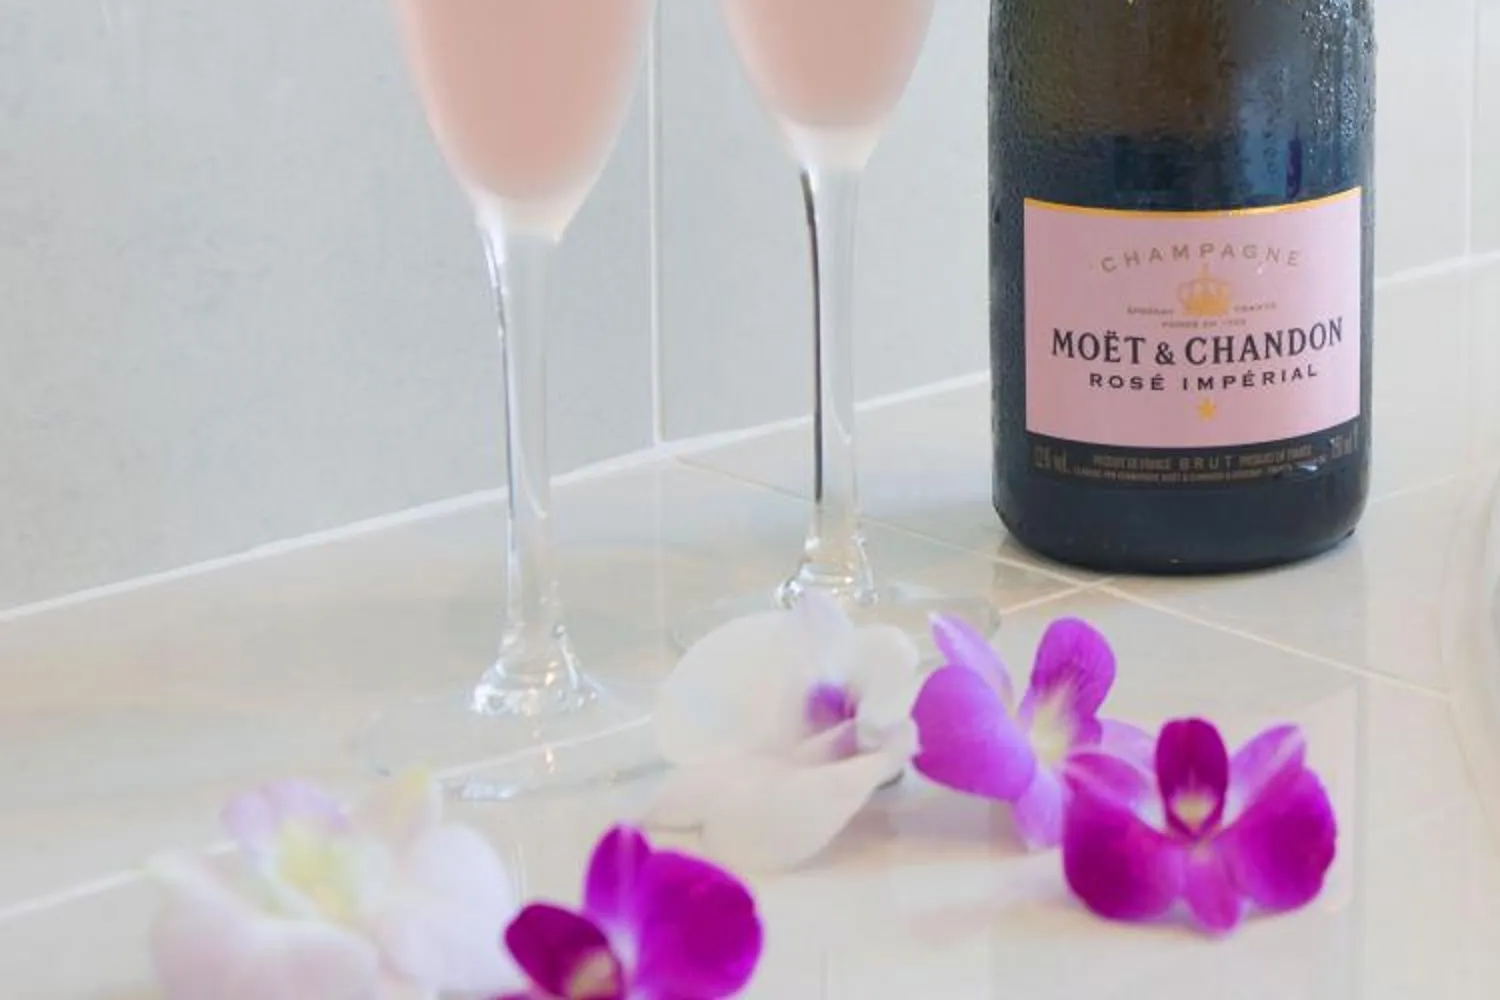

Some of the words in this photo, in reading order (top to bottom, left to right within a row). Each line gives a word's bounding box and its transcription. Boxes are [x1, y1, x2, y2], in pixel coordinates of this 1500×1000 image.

[1101, 242, 1300, 273] CHAMPAGNE
[1051, 328, 1147, 366] MOËT
[1155, 341, 1177, 366] &
[1185, 316, 1344, 366] CHANDON
[1089, 373, 1165, 391] ROSÉ
[1182, 363, 1318, 391] IMPÉRIAL
